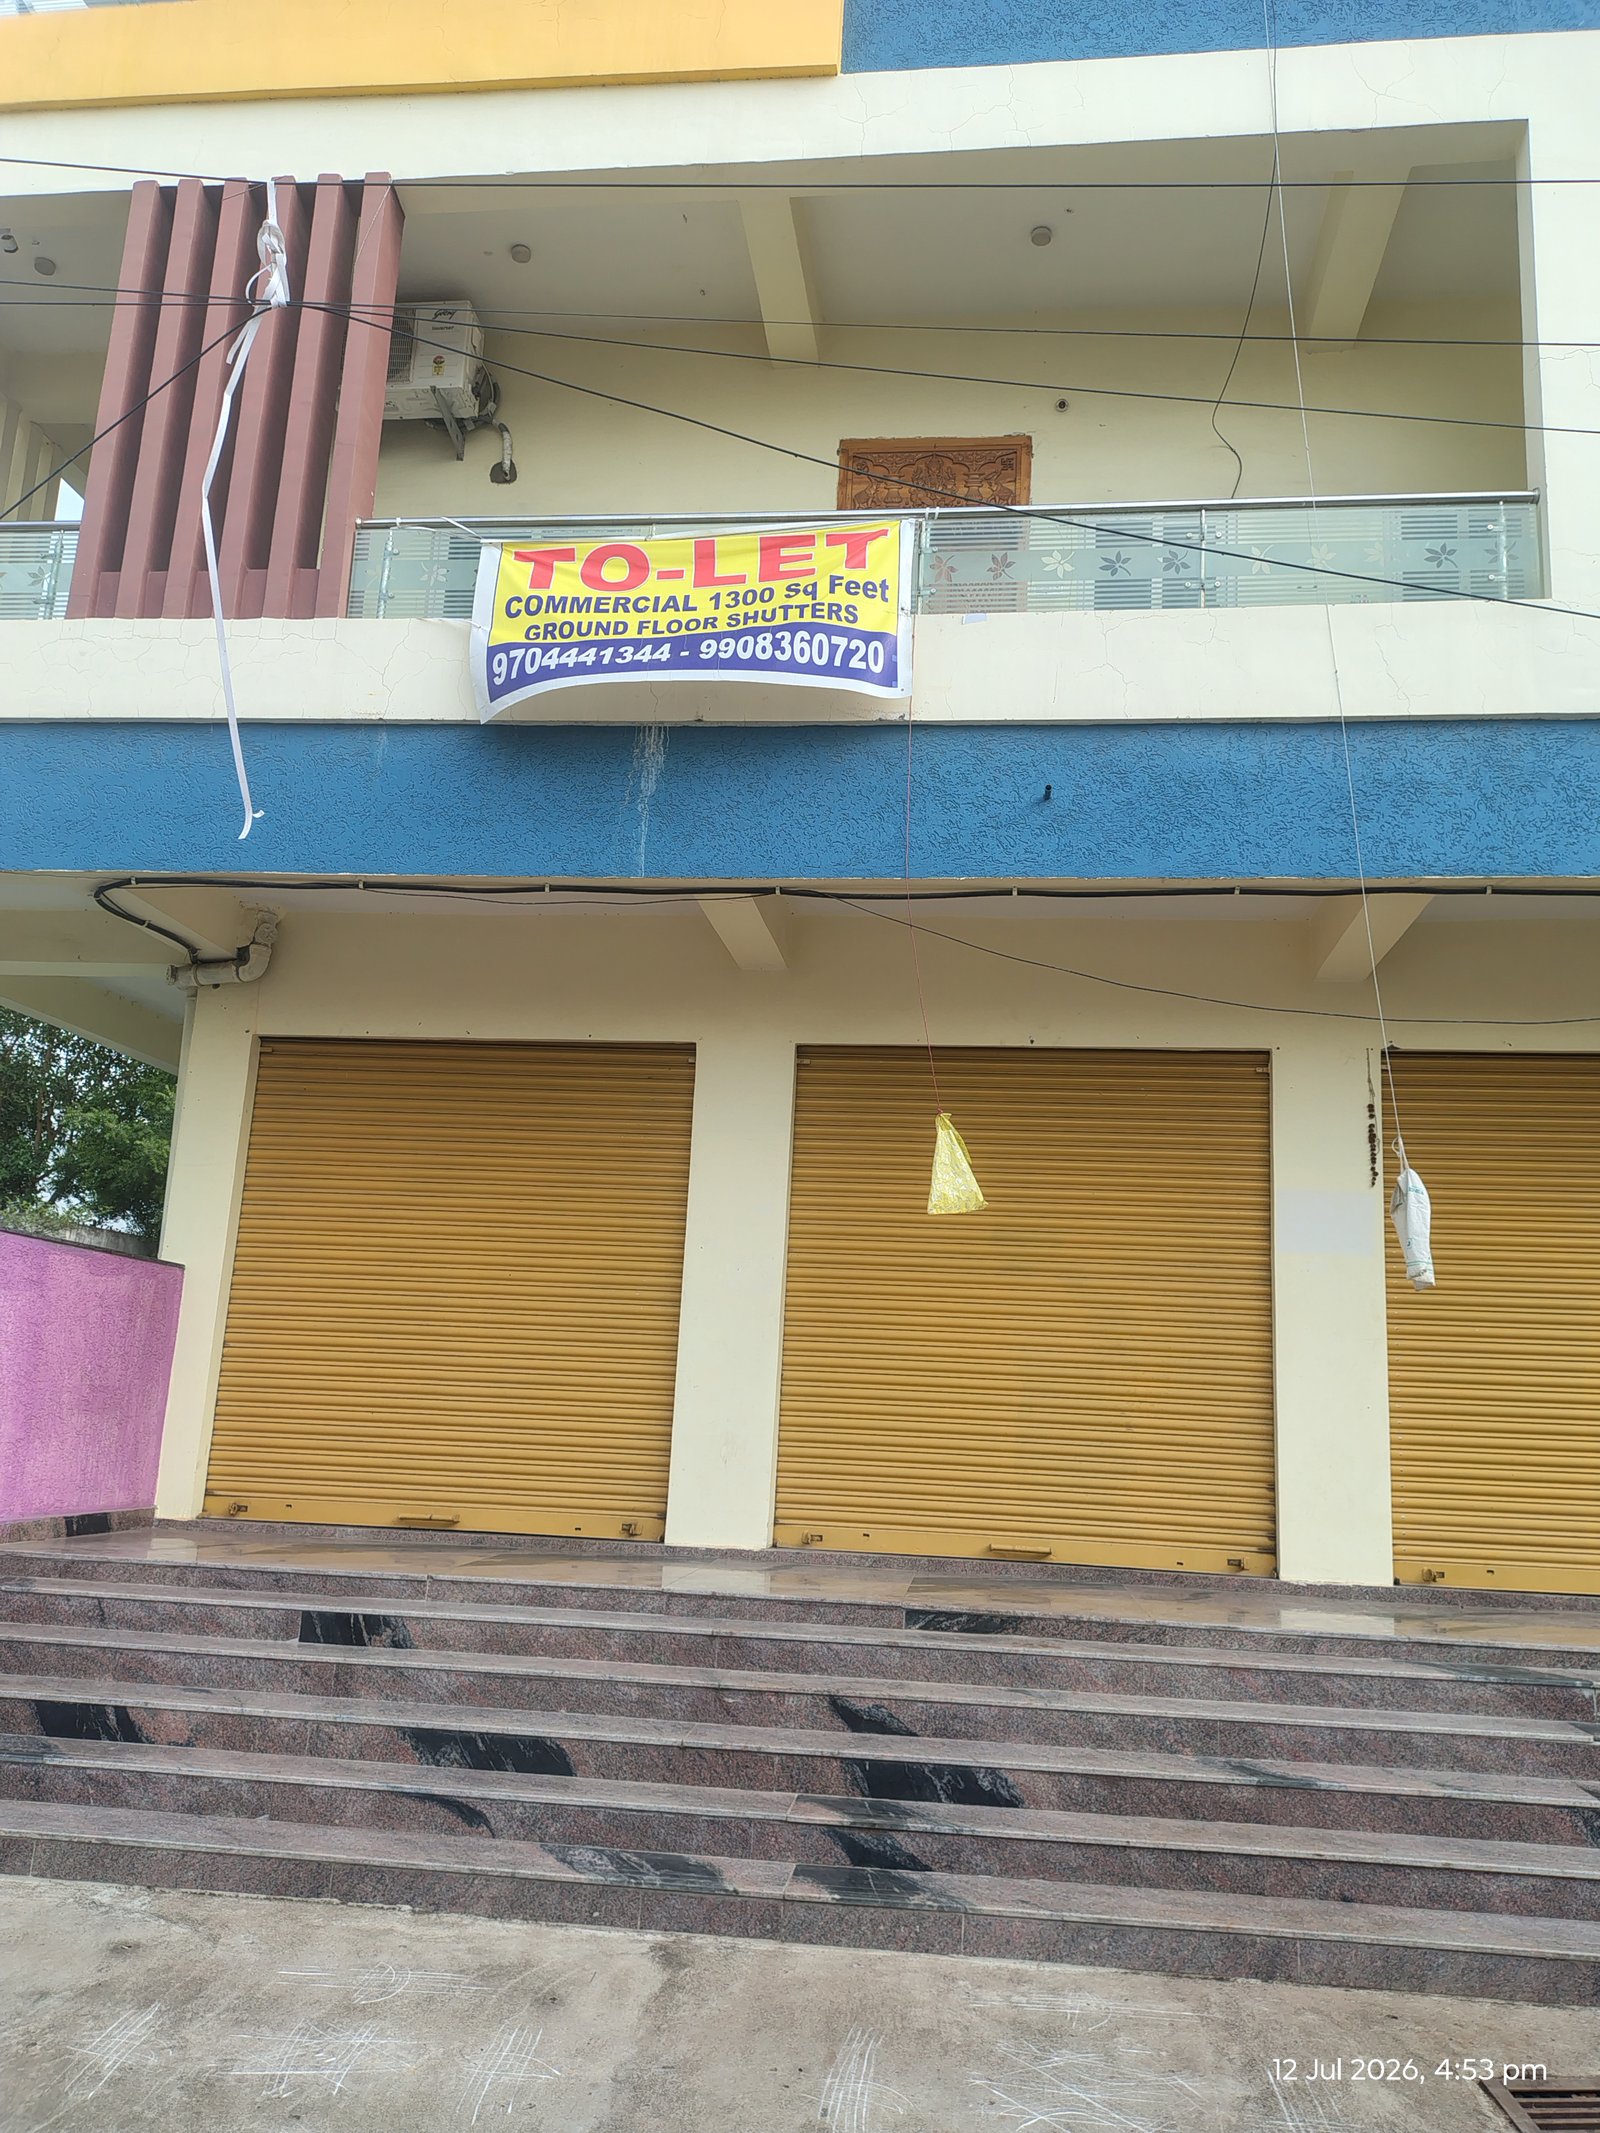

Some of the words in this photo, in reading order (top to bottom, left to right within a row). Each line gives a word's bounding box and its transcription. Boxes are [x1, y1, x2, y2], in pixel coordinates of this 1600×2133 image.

[514, 529, 889, 591] TO-LET
[505, 595, 697, 619] COMMERCIAL
[709, 587, 774, 611] 1300
[829, 575, 889, 602] Feet
[524, 619, 628, 641] GROUND
[637, 616, 718, 636] FLOOR
[727, 602, 859, 627] SHUTTERS
[492, 642, 671, 685] 9704441344
[699, 631, 885, 673] 9908360720
